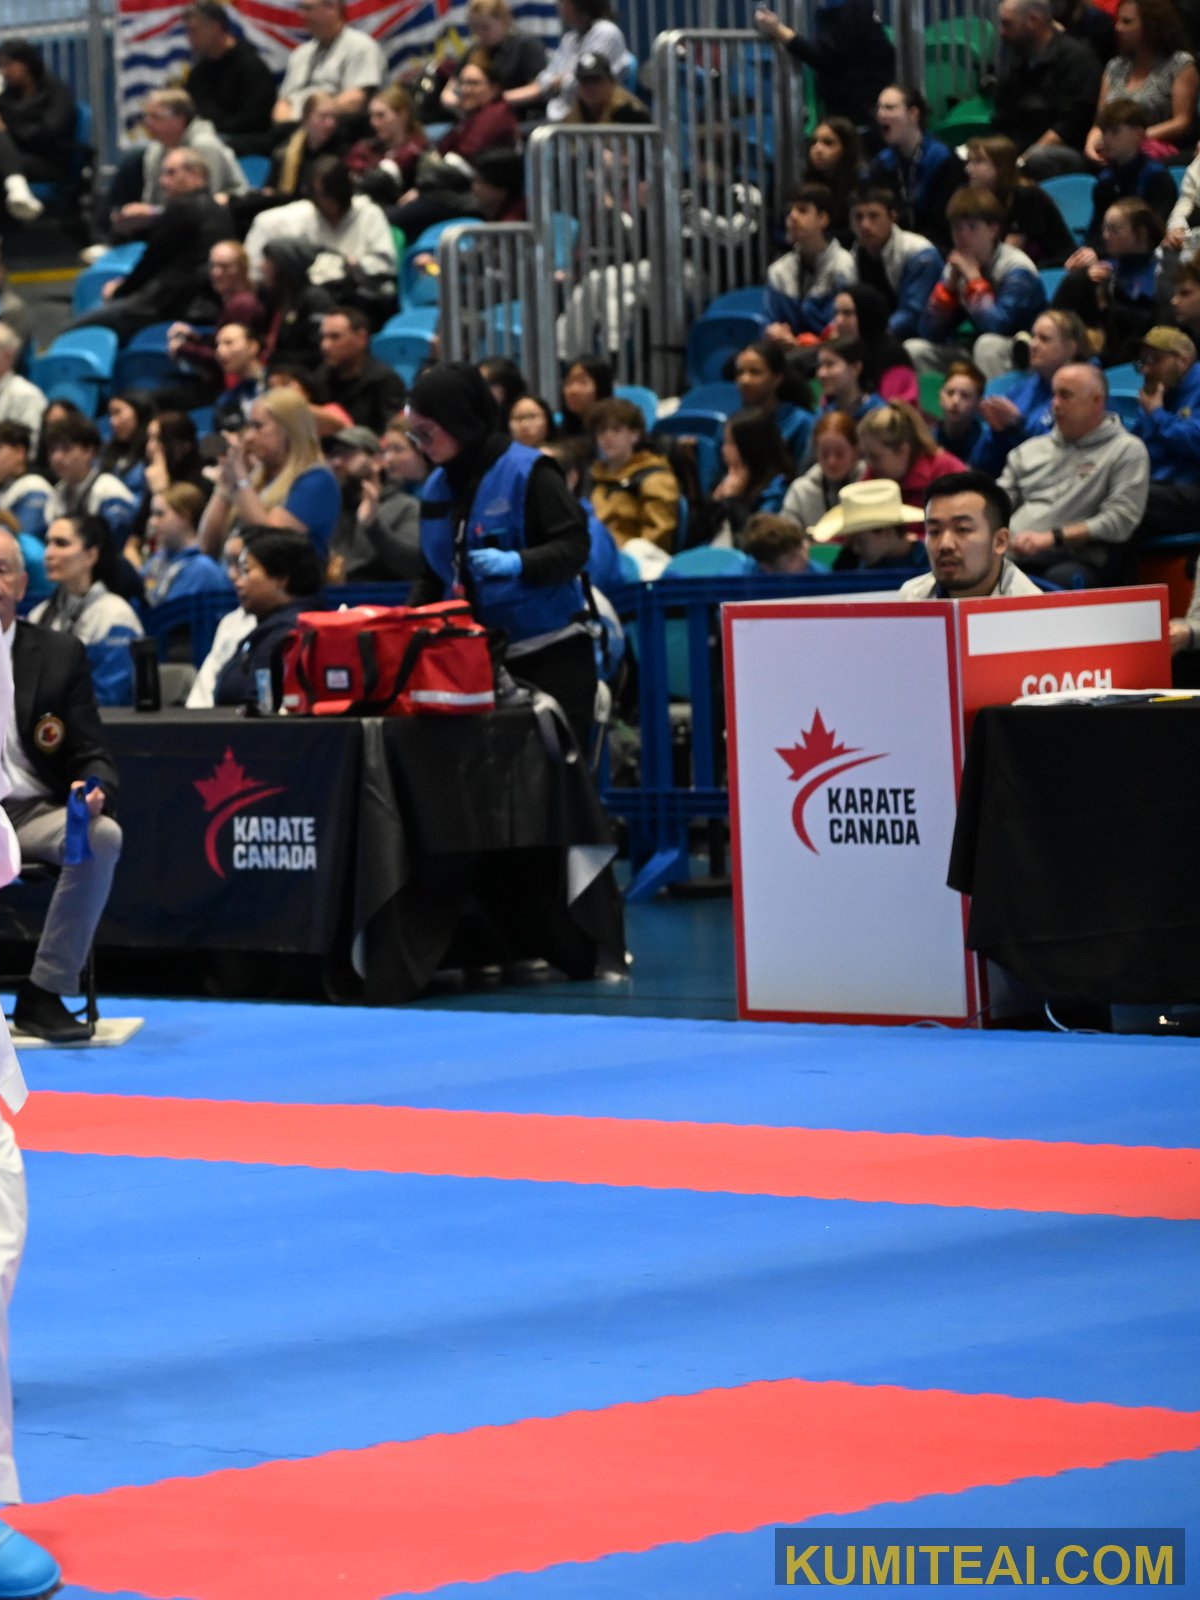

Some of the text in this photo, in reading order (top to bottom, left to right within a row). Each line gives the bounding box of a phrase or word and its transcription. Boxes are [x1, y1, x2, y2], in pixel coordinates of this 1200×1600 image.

[1021, 668, 1112, 697] COACH
[827, 787, 916, 815] KARATE
[233, 816, 316, 842] KARATE
[829, 818, 920, 846] CANADA
[233, 843, 317, 870] CANADA
